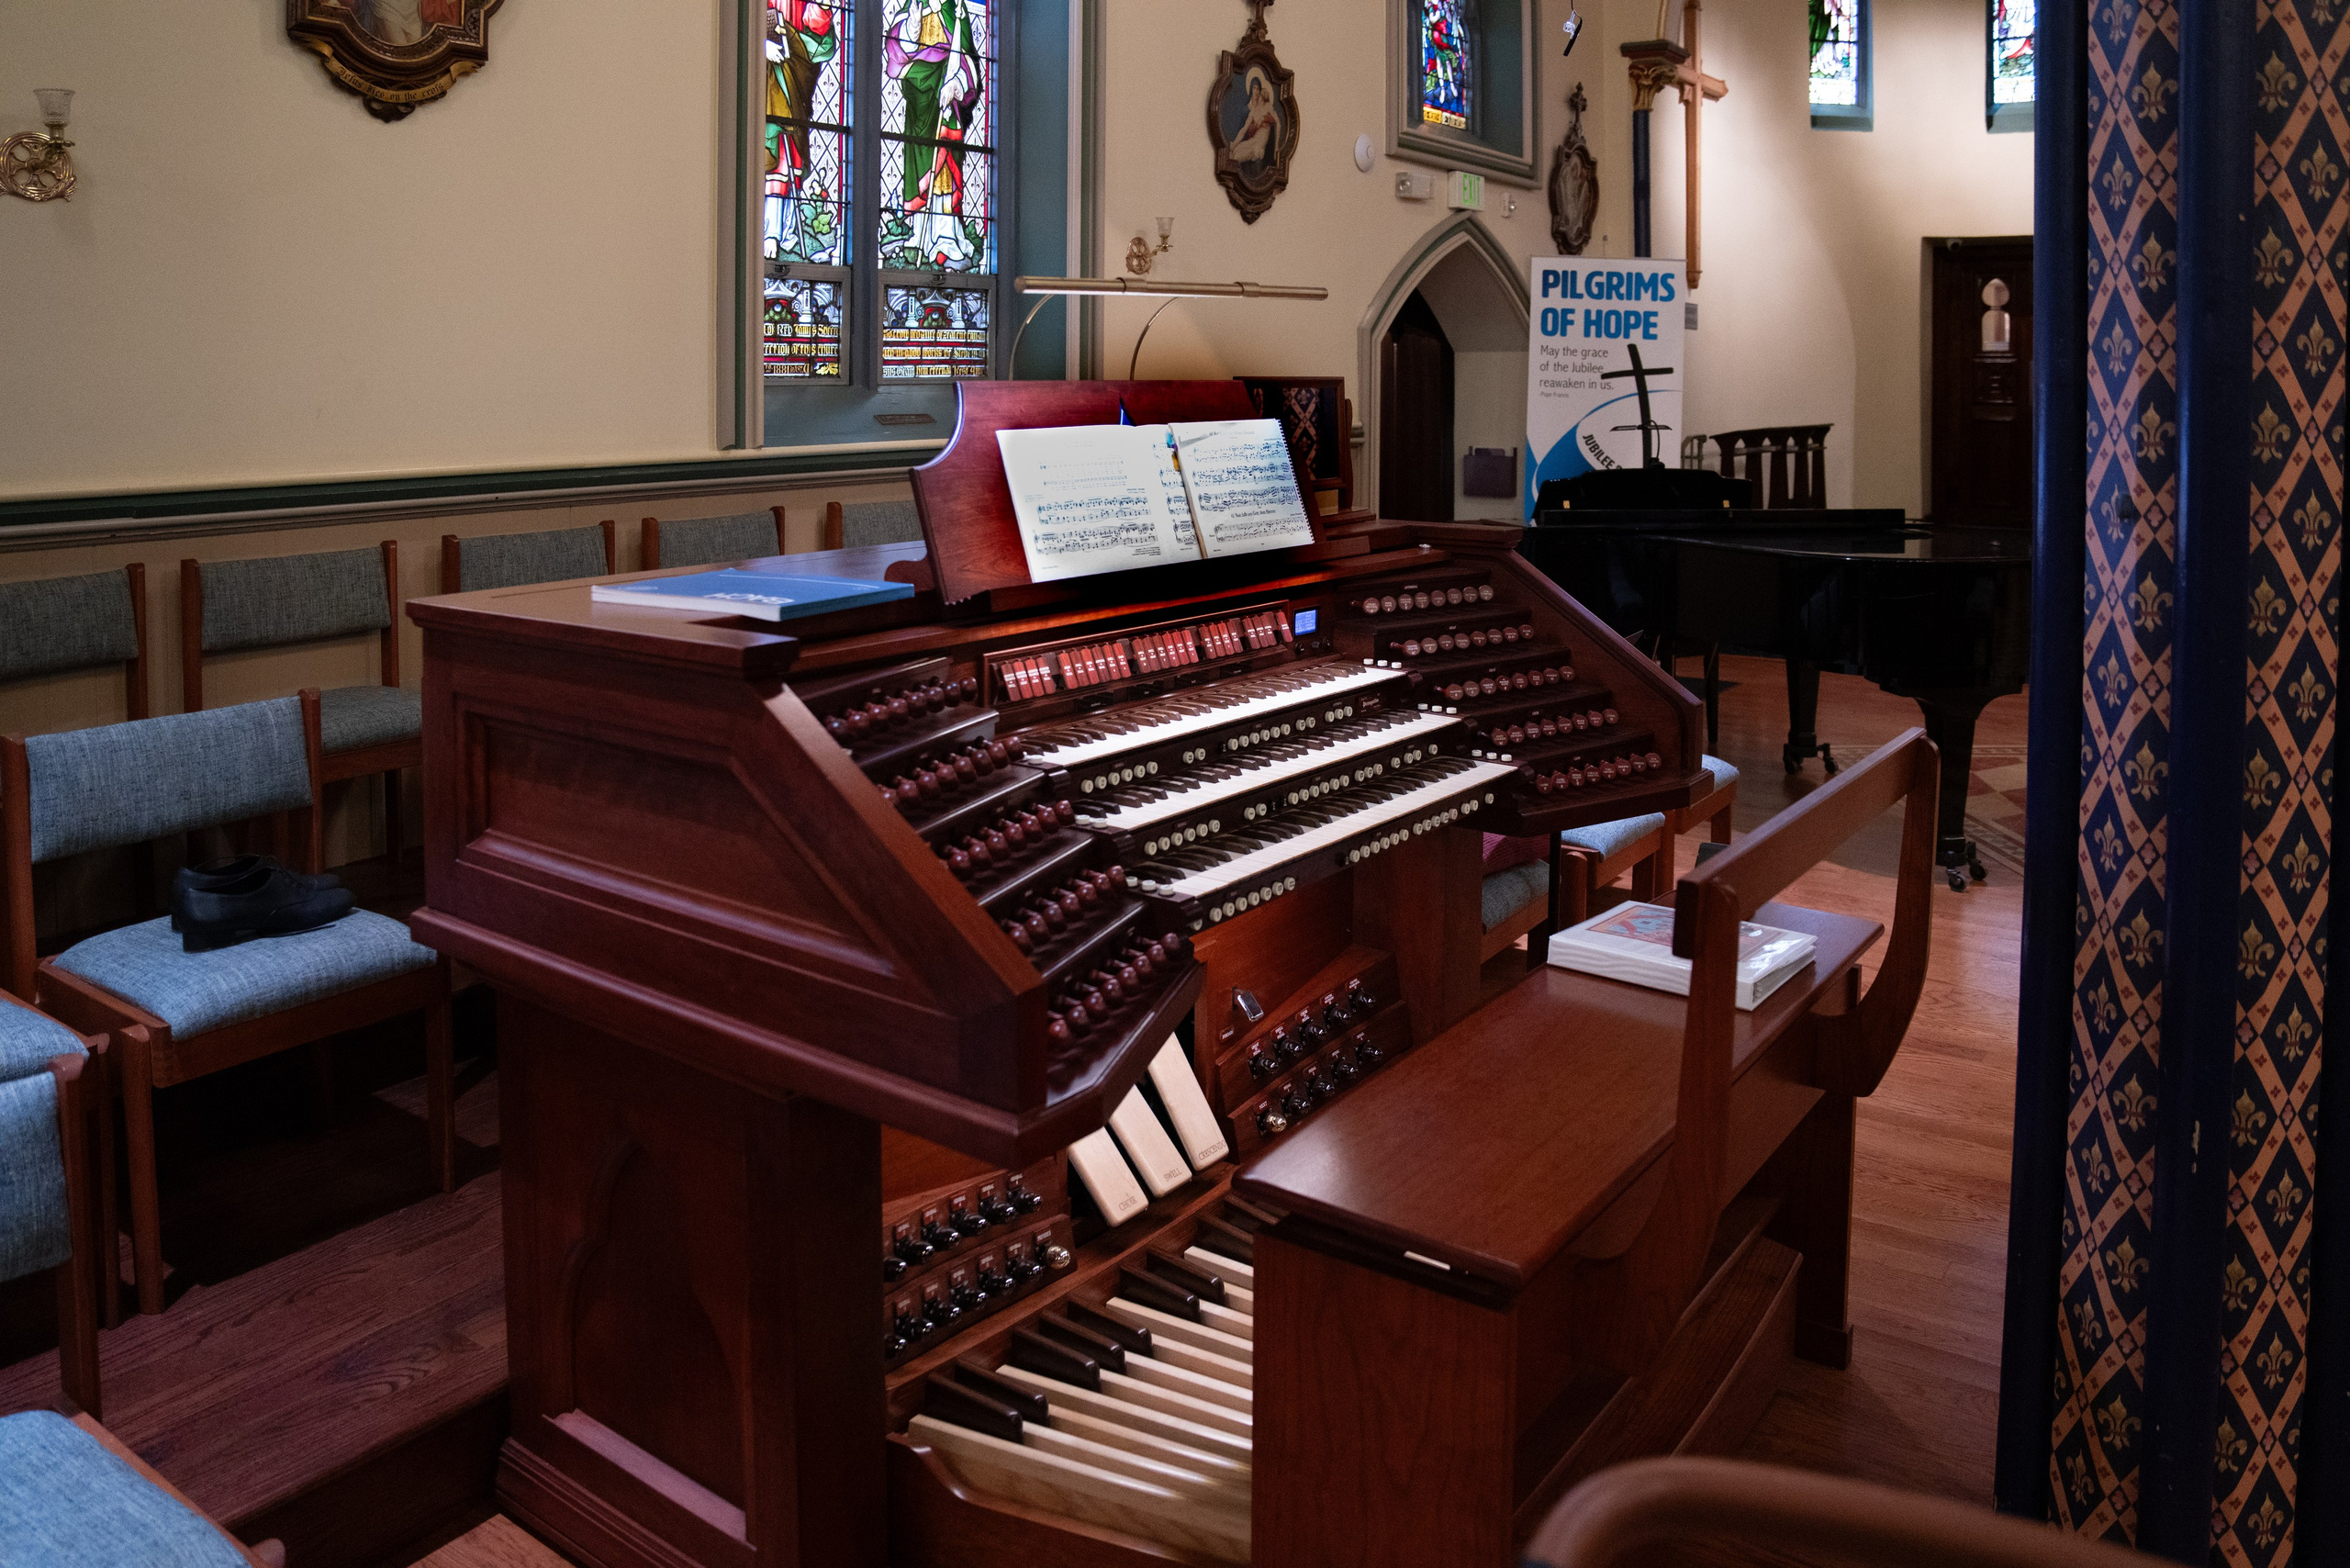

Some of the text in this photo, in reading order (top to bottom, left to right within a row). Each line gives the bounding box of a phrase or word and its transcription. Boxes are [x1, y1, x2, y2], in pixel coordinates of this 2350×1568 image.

[367, 83, 385, 99] dies
[390, 93, 400, 101] on
[404, 91, 417, 101] the
[1463, 173, 1481, 207] EXIT
[1542, 269, 1676, 302] PILGRIMS
[1541, 307, 1658, 340] OF HOPE
[1540, 345, 1609, 360] May the grace
[1539, 361, 1604, 373] of the Jubilee
[1539, 378, 1614, 390] reawaken in us.
[1583, 434, 1615, 470] JUBILEE
[1163, 1168, 1182, 1182] SWELL
[1119, 1196, 1137, 1211] CHOIR
